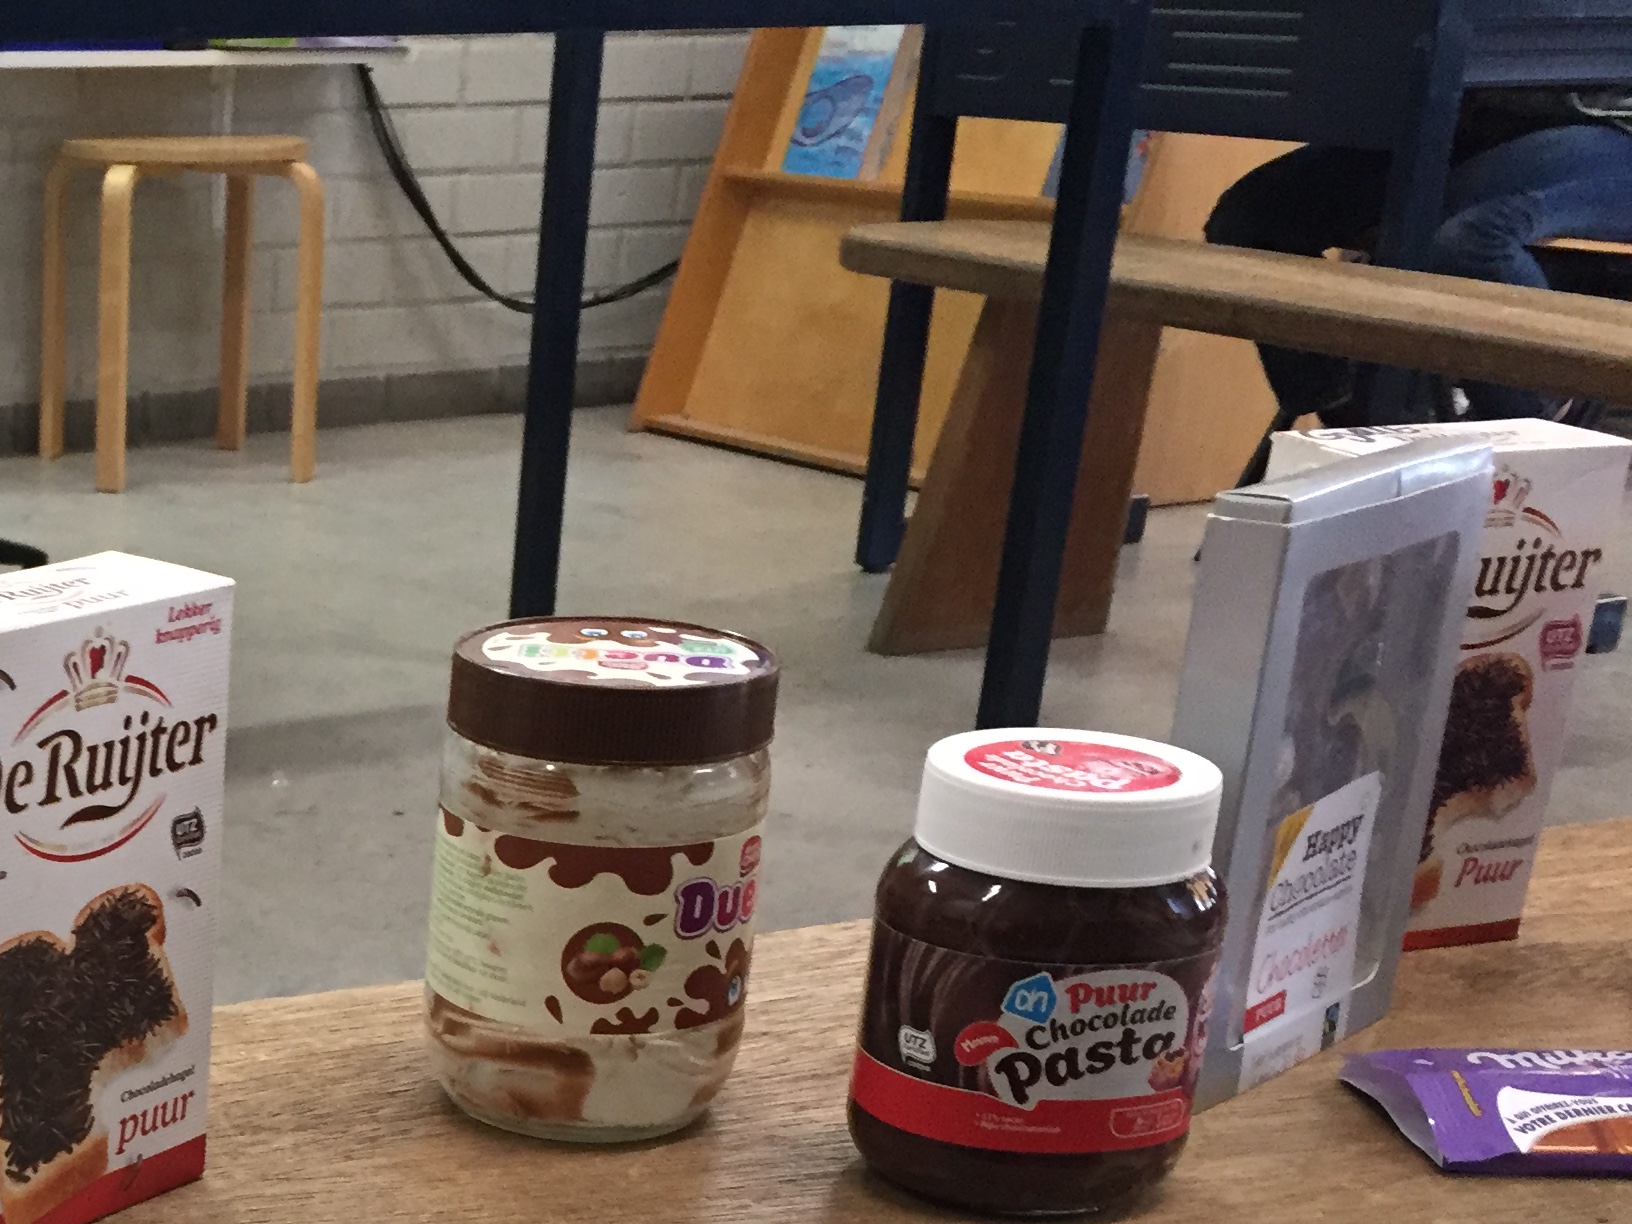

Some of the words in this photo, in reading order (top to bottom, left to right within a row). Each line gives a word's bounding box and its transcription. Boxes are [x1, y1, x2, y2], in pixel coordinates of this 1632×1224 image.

[1466, 537, 1602, 619] uijter
[36, 711, 219, 830] Ruijter
[1025, 1000, 1177, 1050] Chocolade
[1065, 981, 1158, 1014] Puur
[115, 1090, 196, 1155] puur
[1513, 1114, 1557, 1134] VOTRE
[1554, 1104, 1618, 1121] DERNIER
